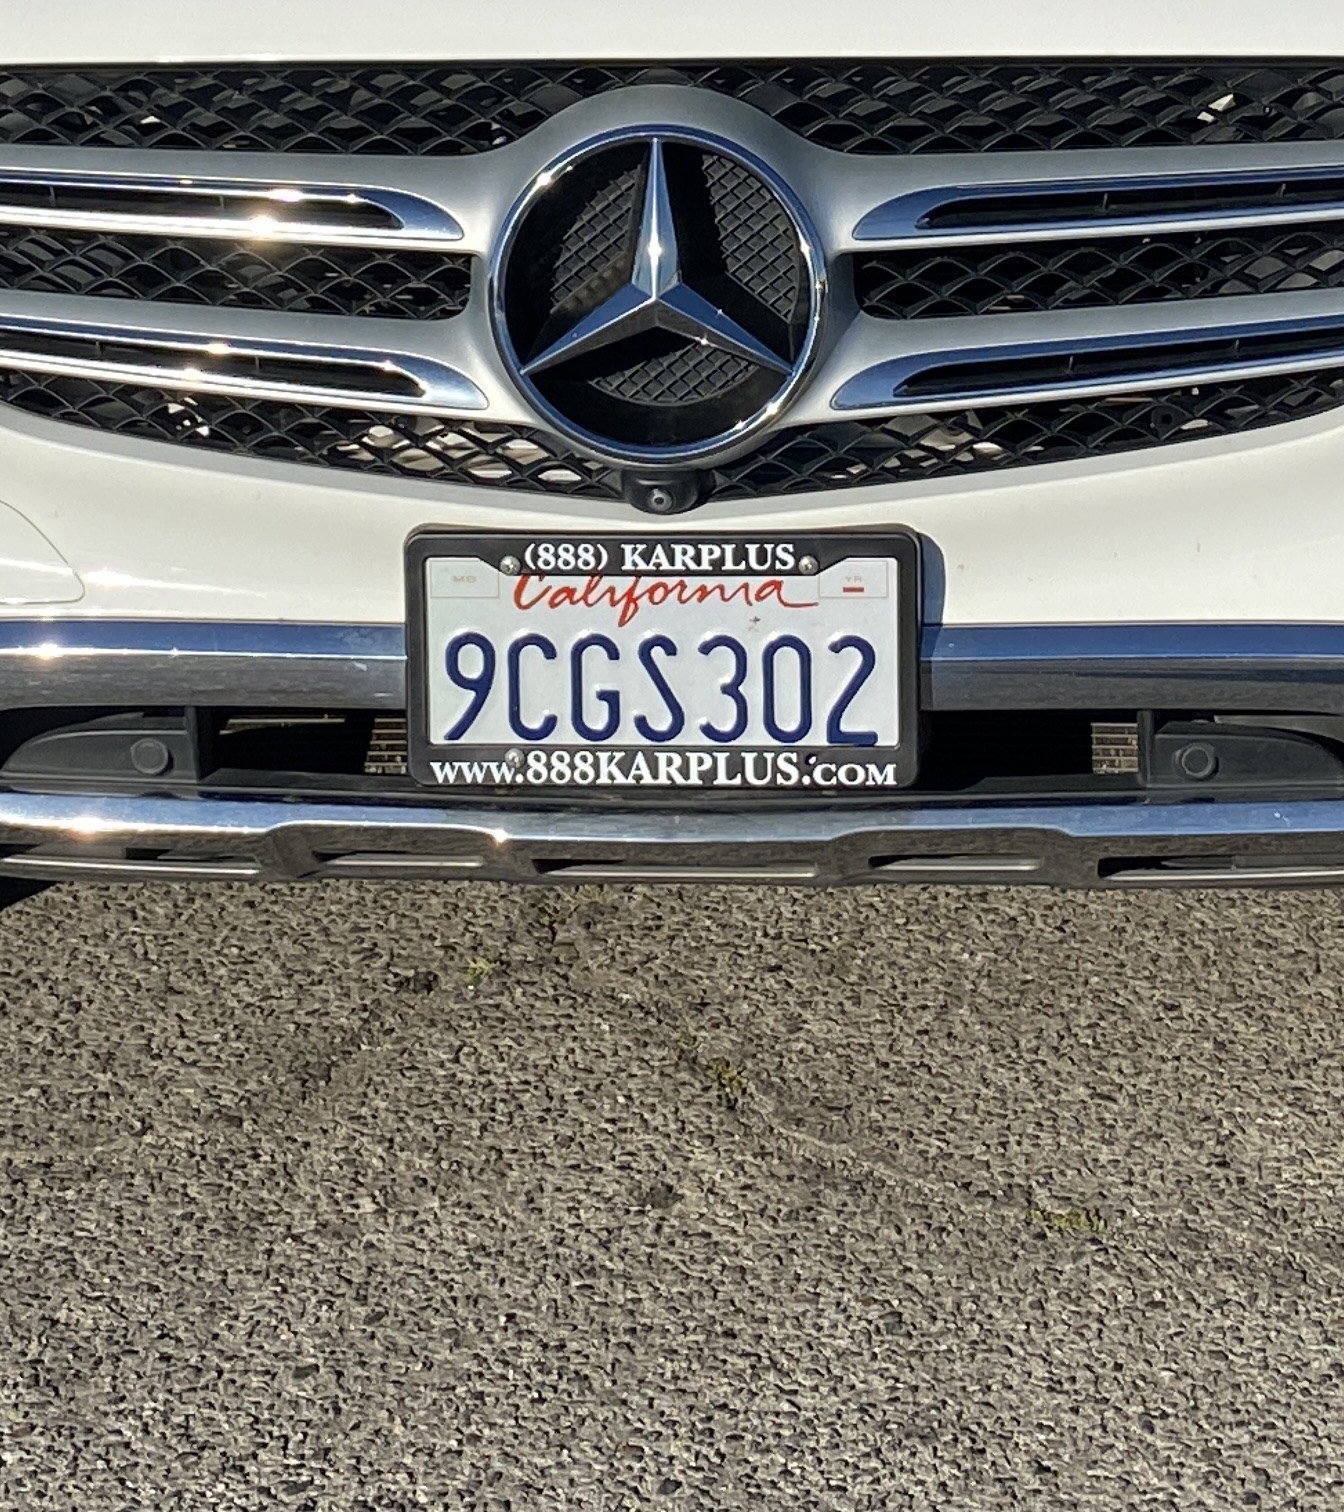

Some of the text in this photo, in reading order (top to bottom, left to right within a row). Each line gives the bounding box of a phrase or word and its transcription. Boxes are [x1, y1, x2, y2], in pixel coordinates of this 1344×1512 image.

[524, 543, 796, 571] (888) KARPLUS
[513, 573, 820, 628] California
[444, 630, 879, 747] 9CGS302
